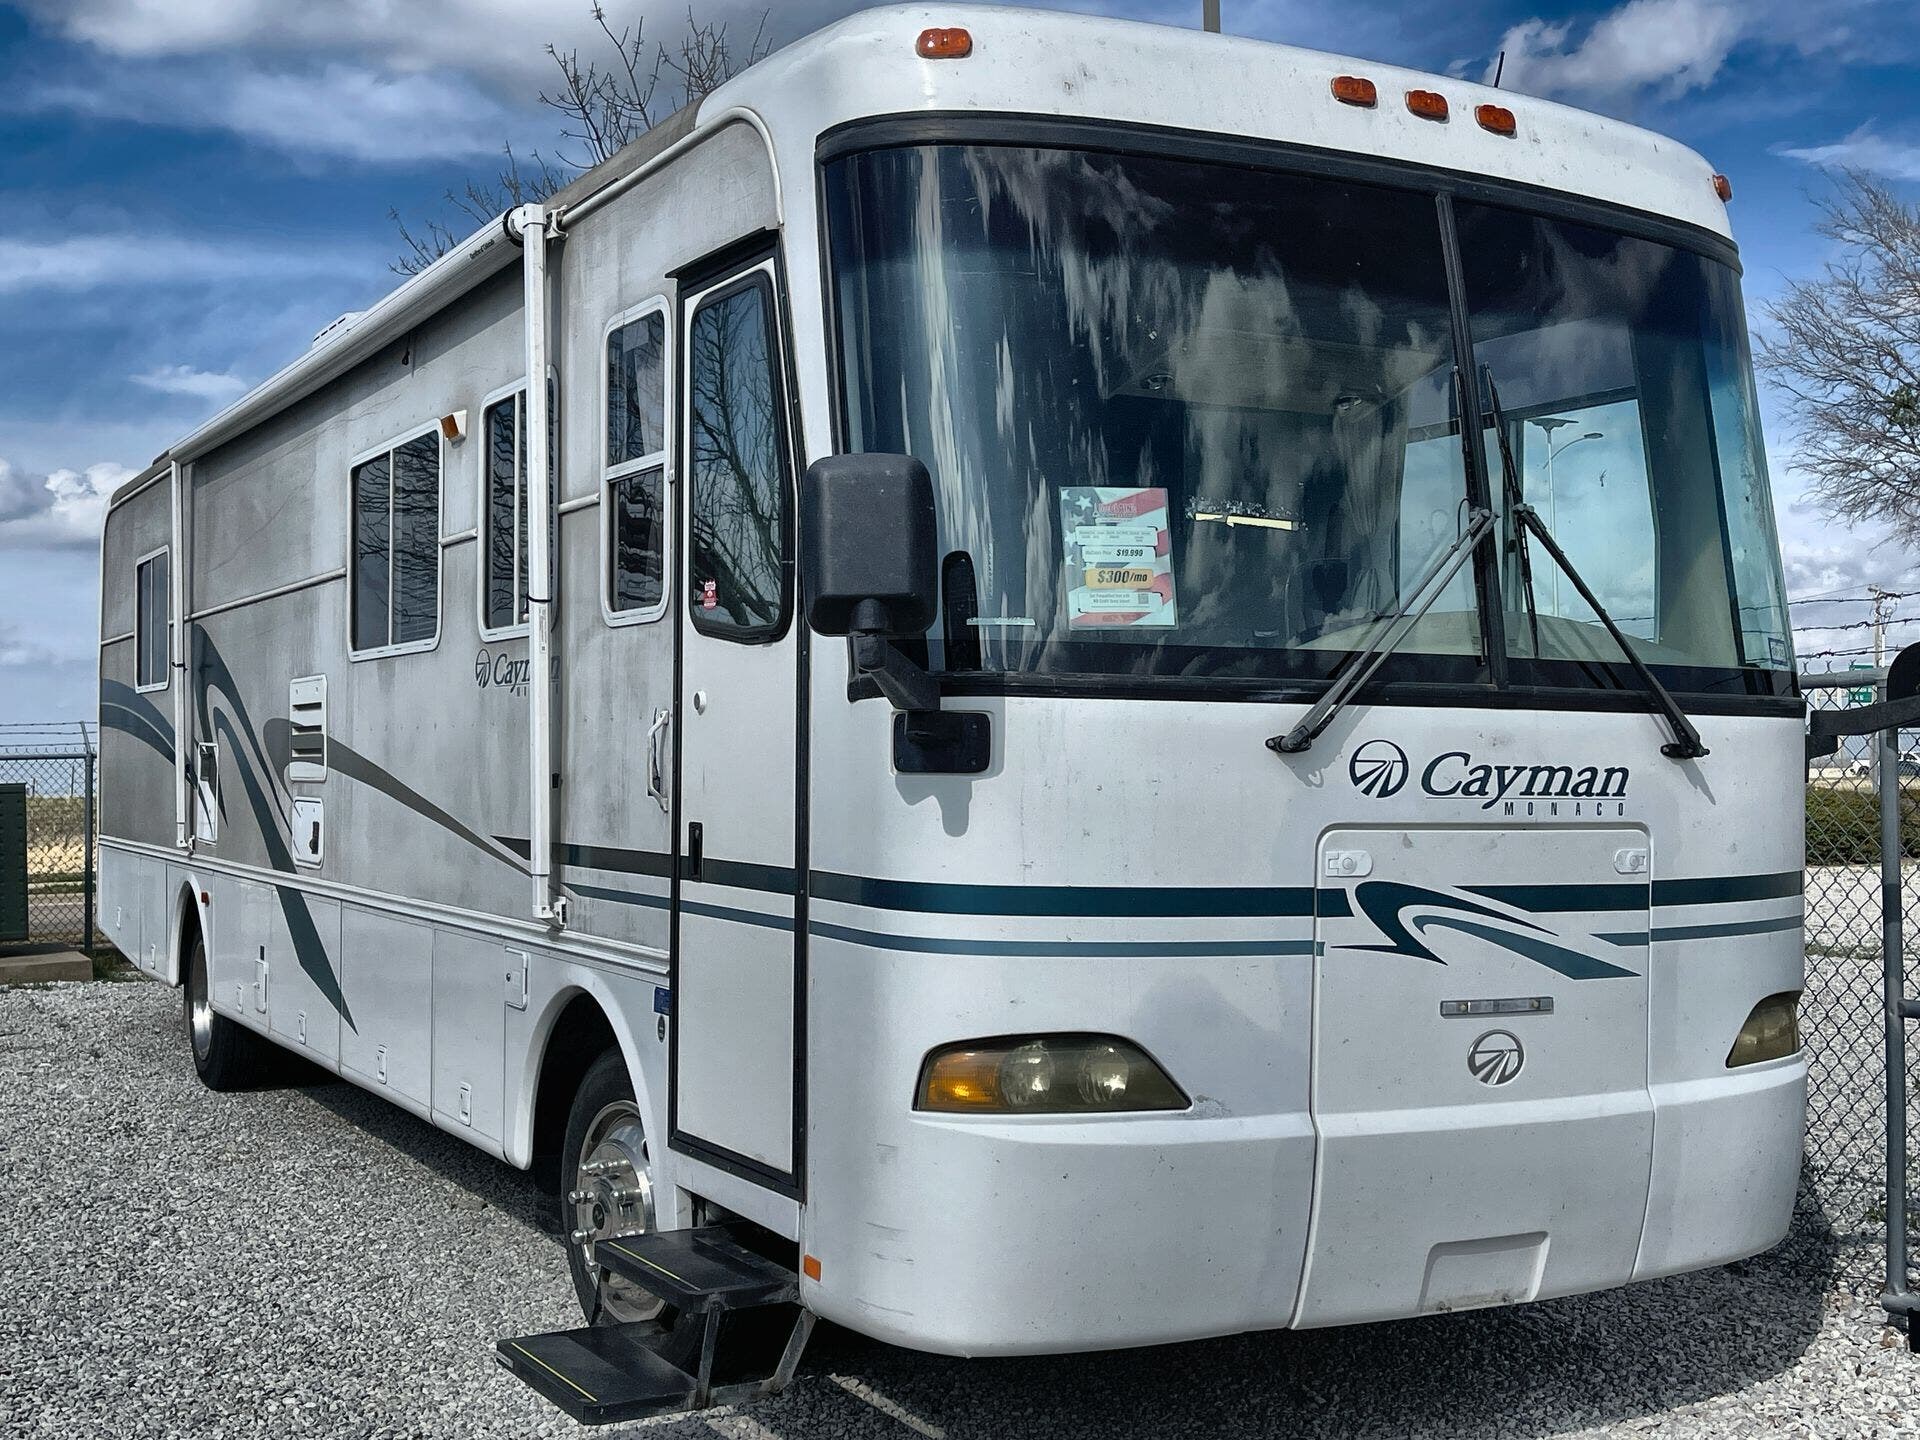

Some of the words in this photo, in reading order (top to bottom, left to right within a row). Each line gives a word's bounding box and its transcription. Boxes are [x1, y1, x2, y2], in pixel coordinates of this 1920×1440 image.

[1097, 570, 1148, 584] $300/mo
[1421, 751, 1630, 811] Cayman
[1504, 802, 1625, 817] MONACO
